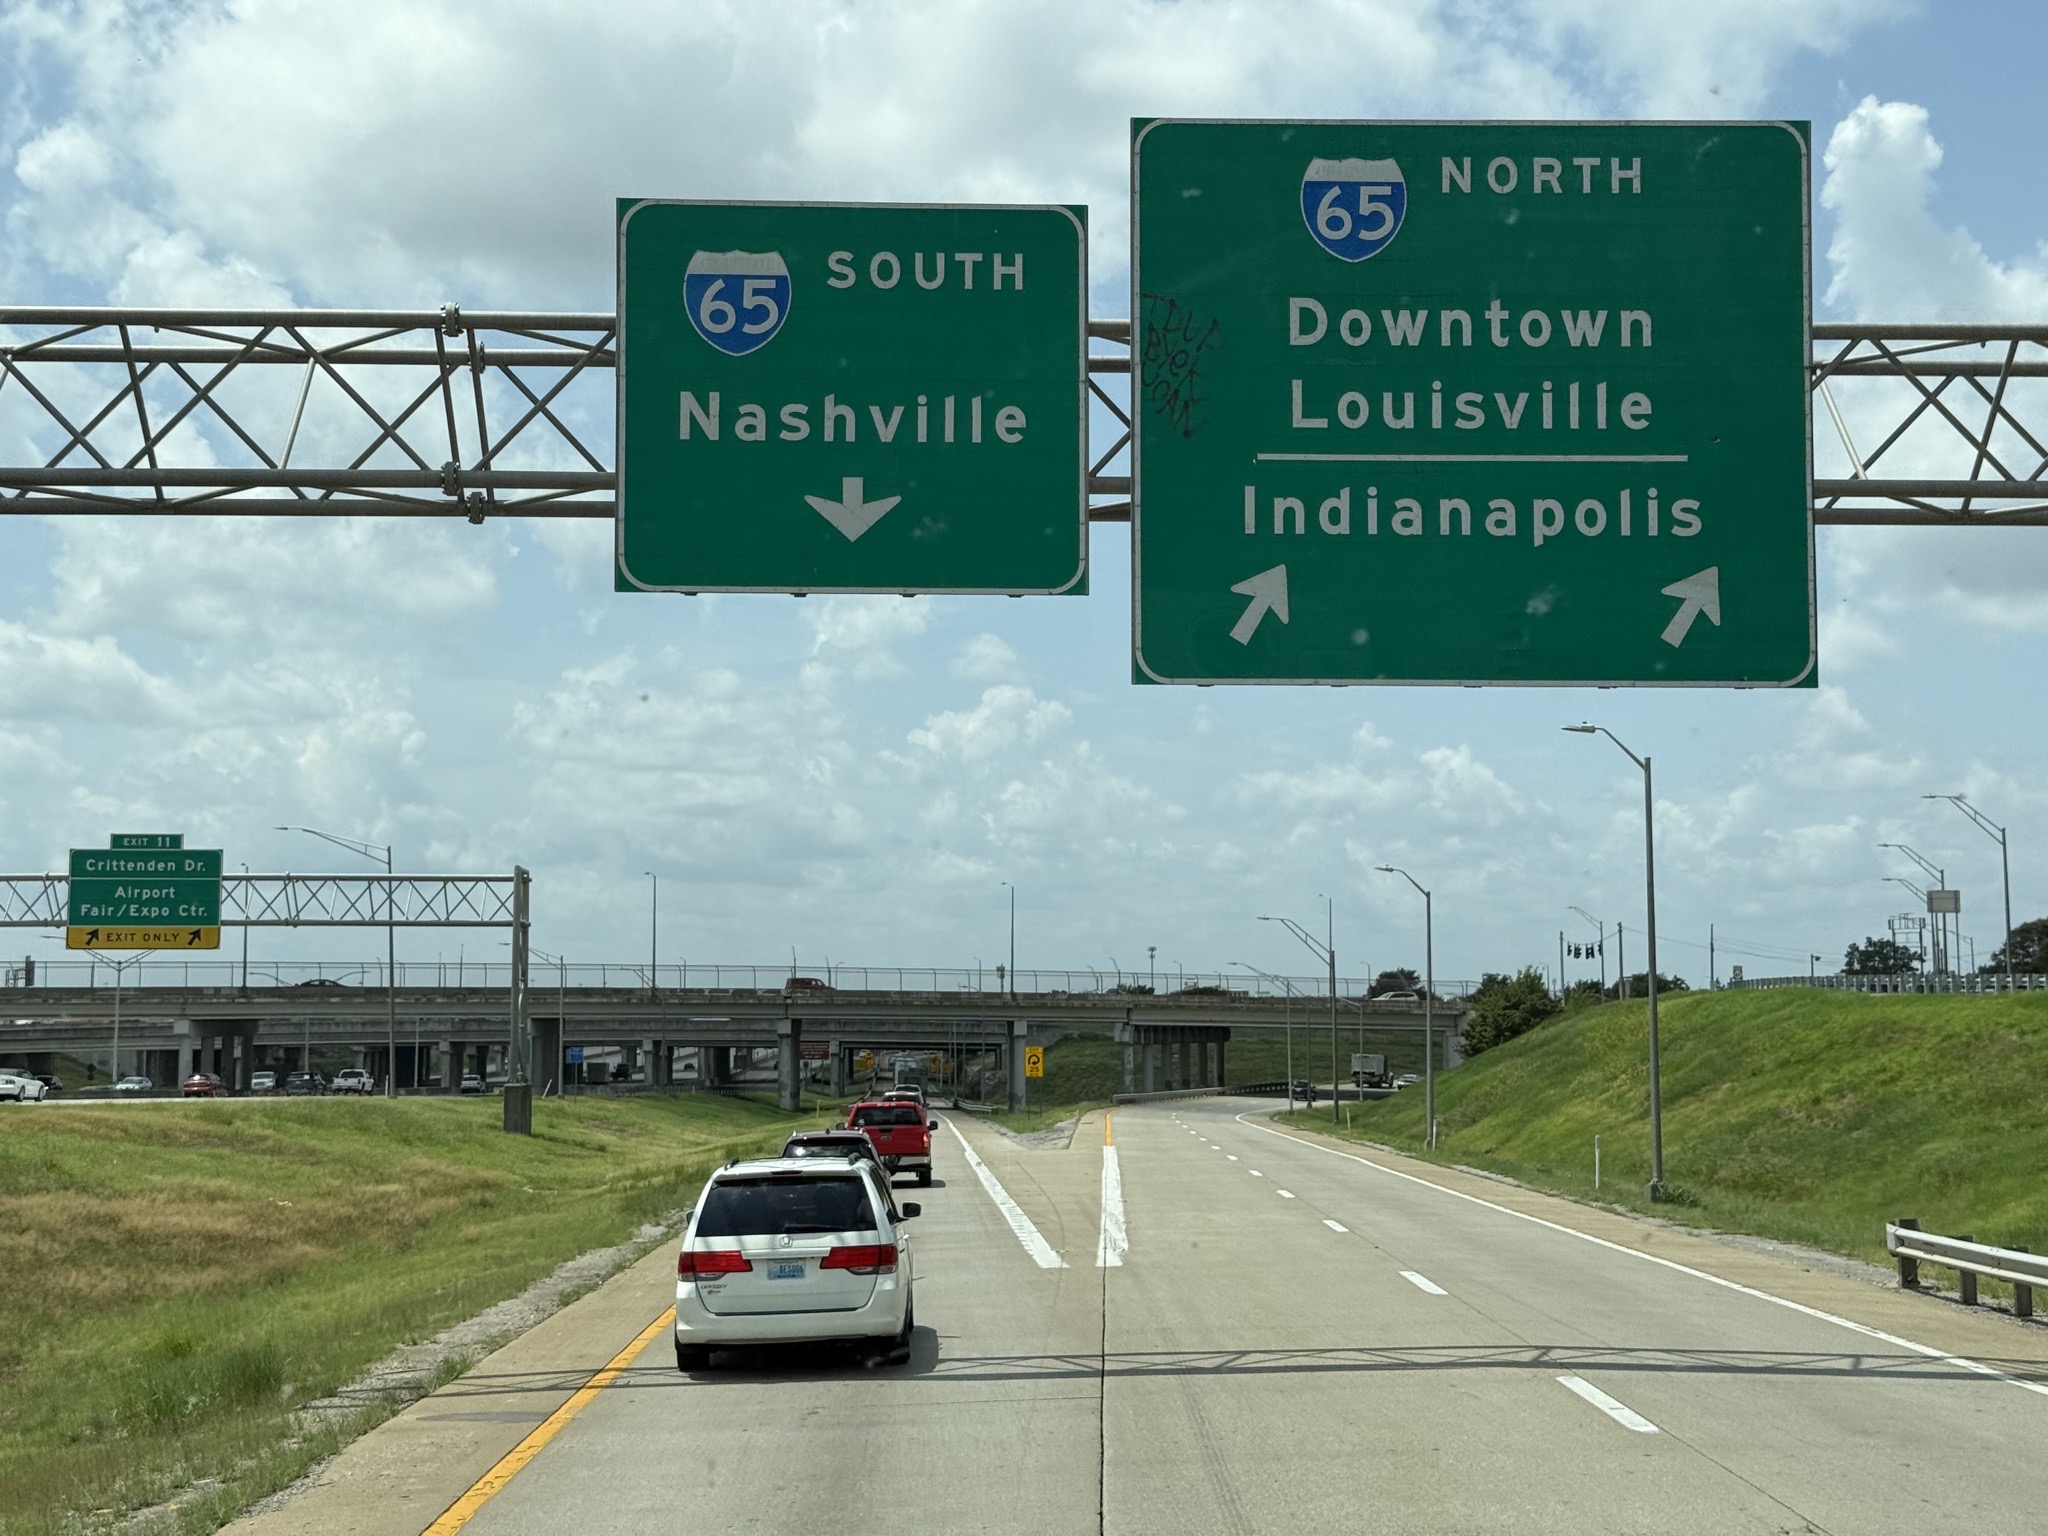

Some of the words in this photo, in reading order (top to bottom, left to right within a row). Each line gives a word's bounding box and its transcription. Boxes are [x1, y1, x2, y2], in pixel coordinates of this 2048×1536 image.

[1315, 184, 1395, 241] 65
[1440, 156, 1642, 194] NORTH
[700, 278, 779, 335] 65
[826, 250, 1024, 291] SOUTH
[1288, 296, 1653, 348] Downtown
[679, 390, 1027, 443] Nashville
[1291, 378, 1653, 430] Louisville
[1244, 484, 1703, 548] Indianapolis
[85, 858, 176, 872] Crittenden
[184, 859, 206, 872] Dr.
[123, 837, 149, 847] EXIT
[157, 836, 171, 848] 11
[80, 904, 170, 918] Fair/Expo
[178, 904, 208, 917] Ctr.
[114, 885, 176, 900] Airport
[106, 932, 137, 942] EXIT
[142, 932, 180, 943] ONLY
